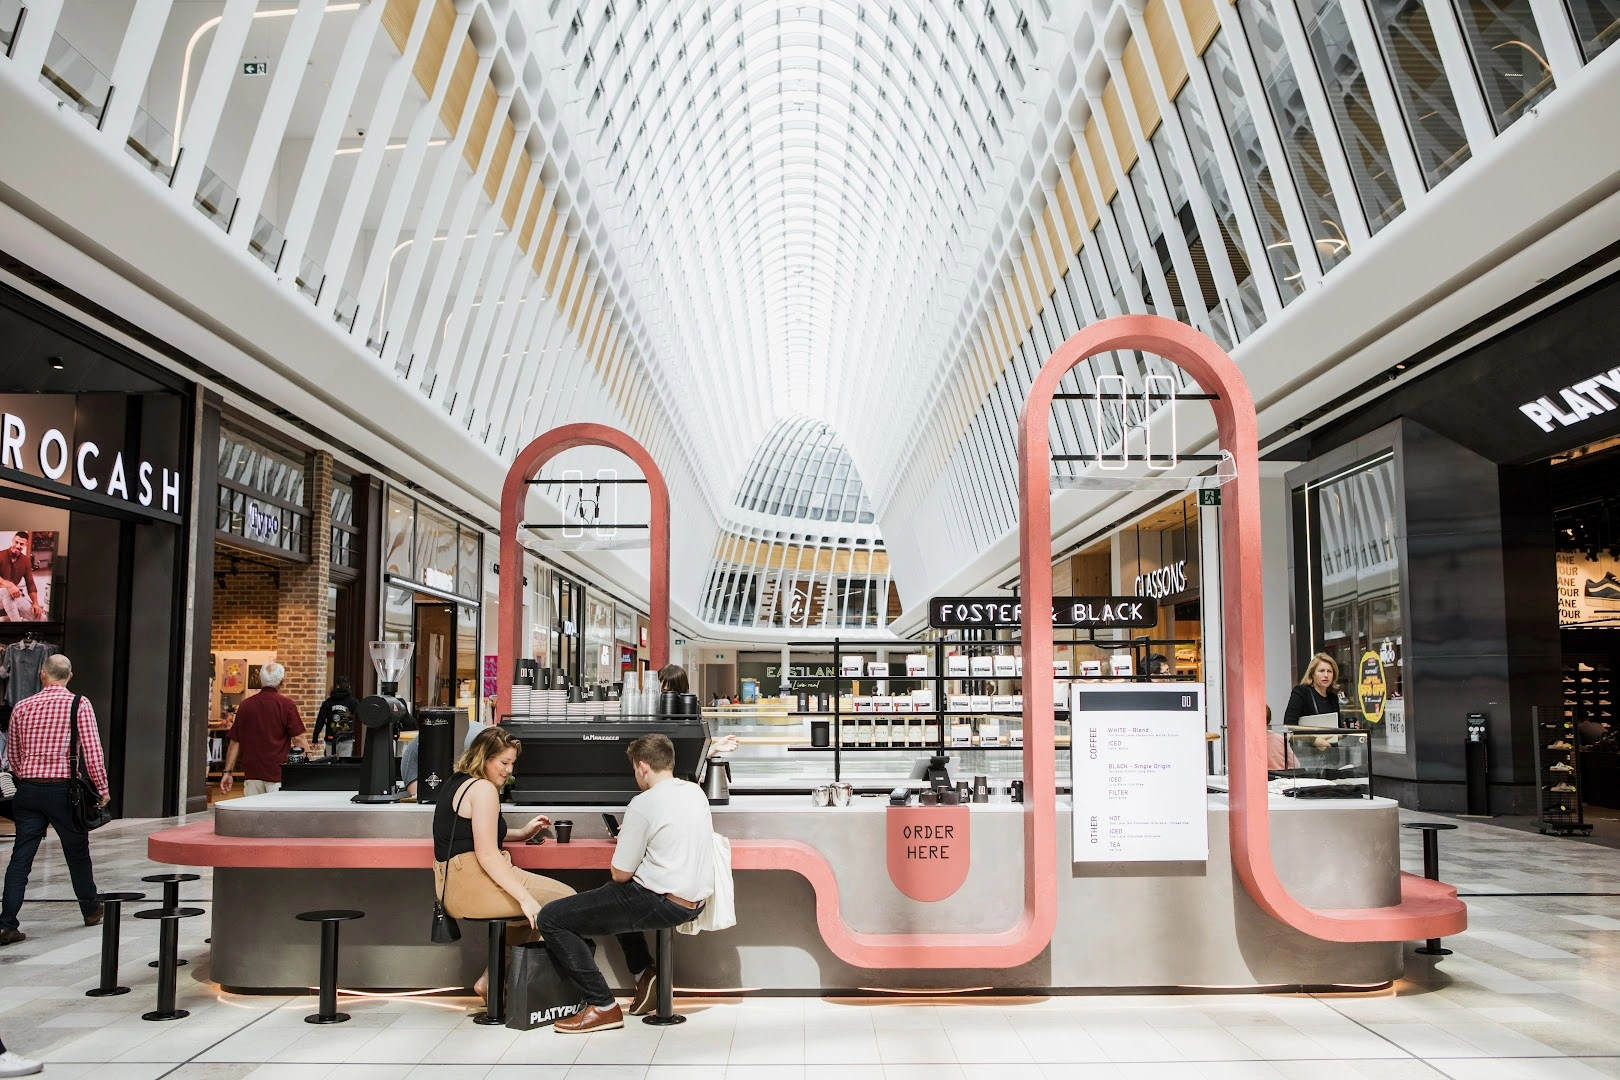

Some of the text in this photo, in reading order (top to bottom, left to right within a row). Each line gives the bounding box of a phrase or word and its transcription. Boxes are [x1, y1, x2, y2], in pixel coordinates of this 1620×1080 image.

[1, 413, 180, 514] ROCASH
[249, 502, 279, 539] Typo
[1557, 566, 1579, 576] OUR
[1073, 603, 1143, 622] BLACK
[1089, 727, 1097, 760] COFFEE
[903, 825, 954, 839] ORDER
[1090, 815, 1098, 844] OTHER
[907, 845, 949, 859] HERE
